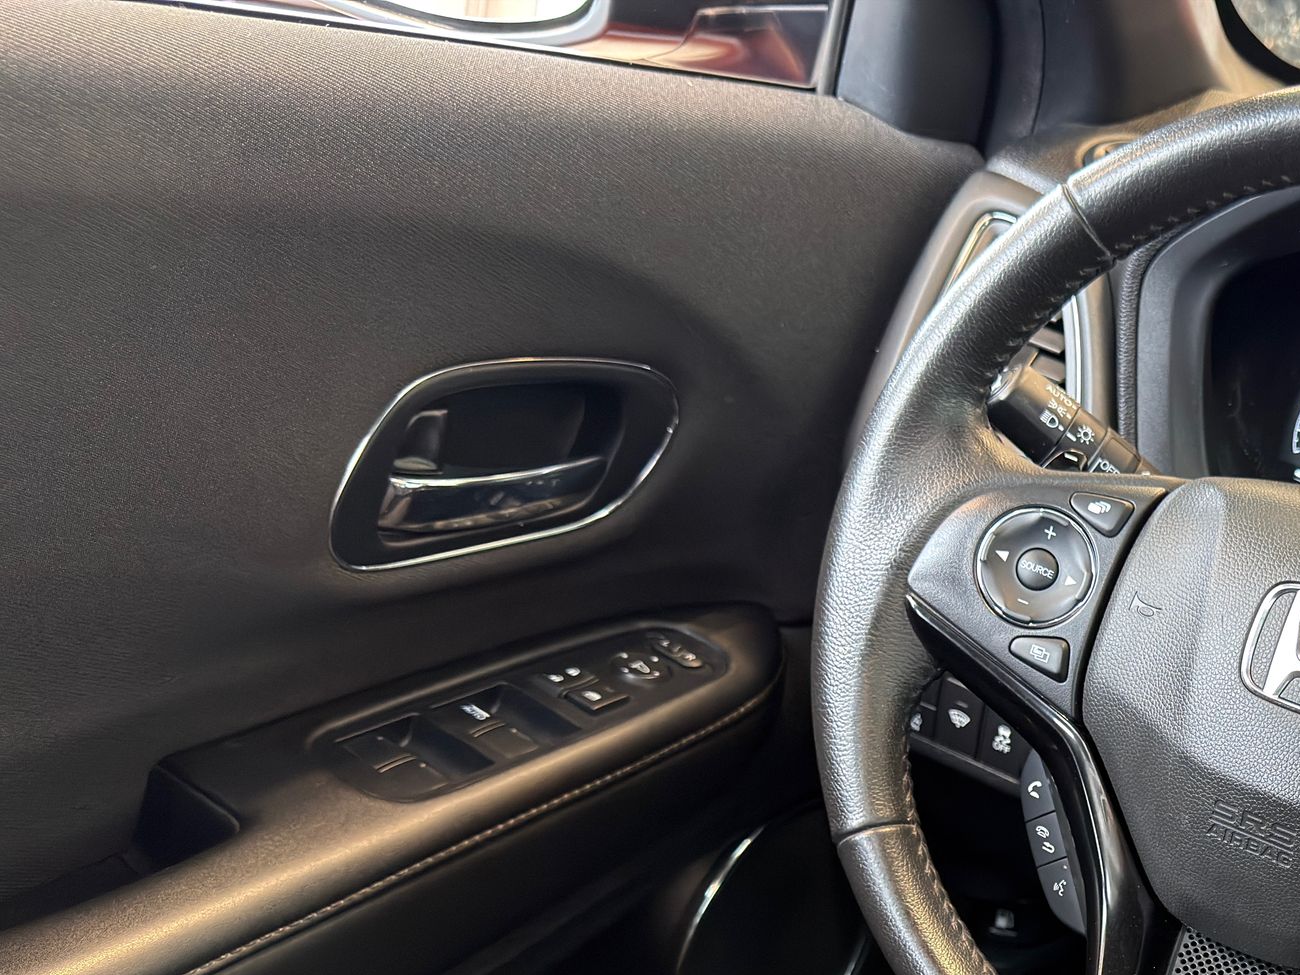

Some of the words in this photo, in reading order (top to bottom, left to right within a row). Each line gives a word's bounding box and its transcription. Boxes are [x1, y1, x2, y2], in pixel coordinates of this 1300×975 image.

[1046, 384, 1072, 407] AUTO
[1019, 559, 1055, 579] SOURCE
[1212, 800, 1297, 848] SRS
[1206, 822, 1293, 868] AIRBAG
